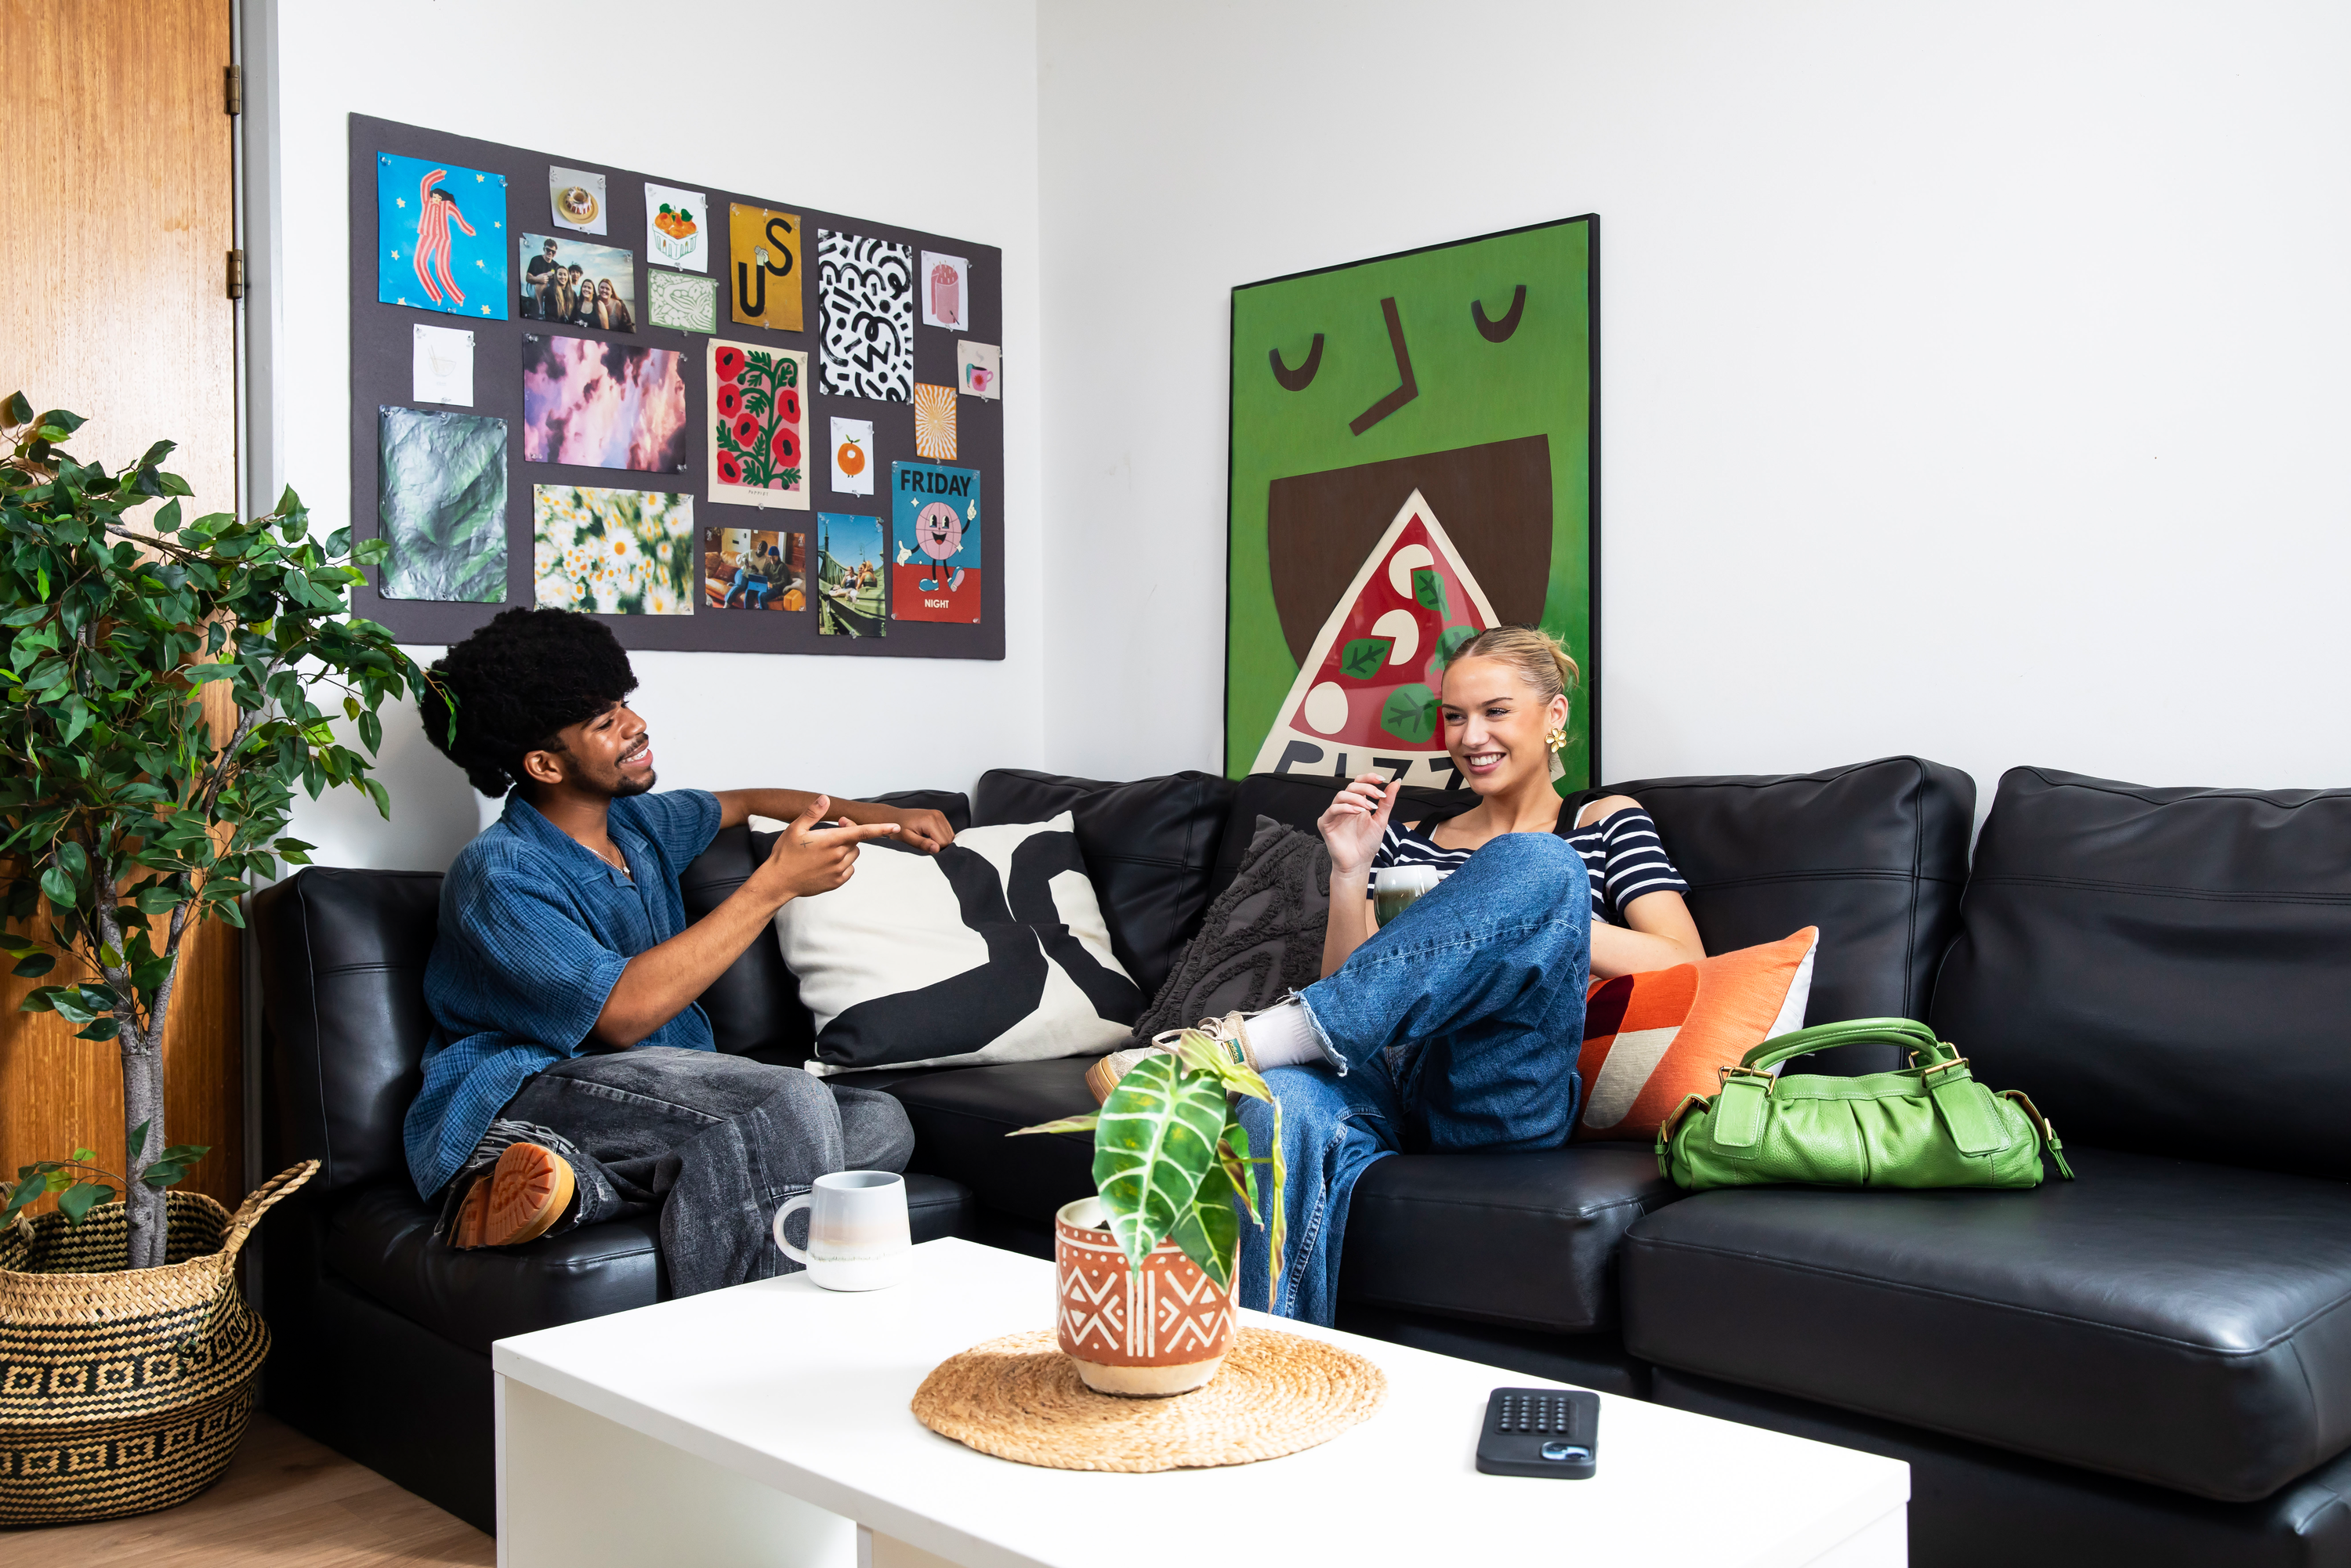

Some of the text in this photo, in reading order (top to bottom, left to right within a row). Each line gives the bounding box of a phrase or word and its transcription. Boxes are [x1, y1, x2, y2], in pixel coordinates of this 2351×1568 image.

[901, 469, 972, 497] FRIDAY
[925, 599, 950, 609] NIGHT
[1273, 740, 1465, 790] PIZZ
[1228, 1040, 1240, 1063] adidas
